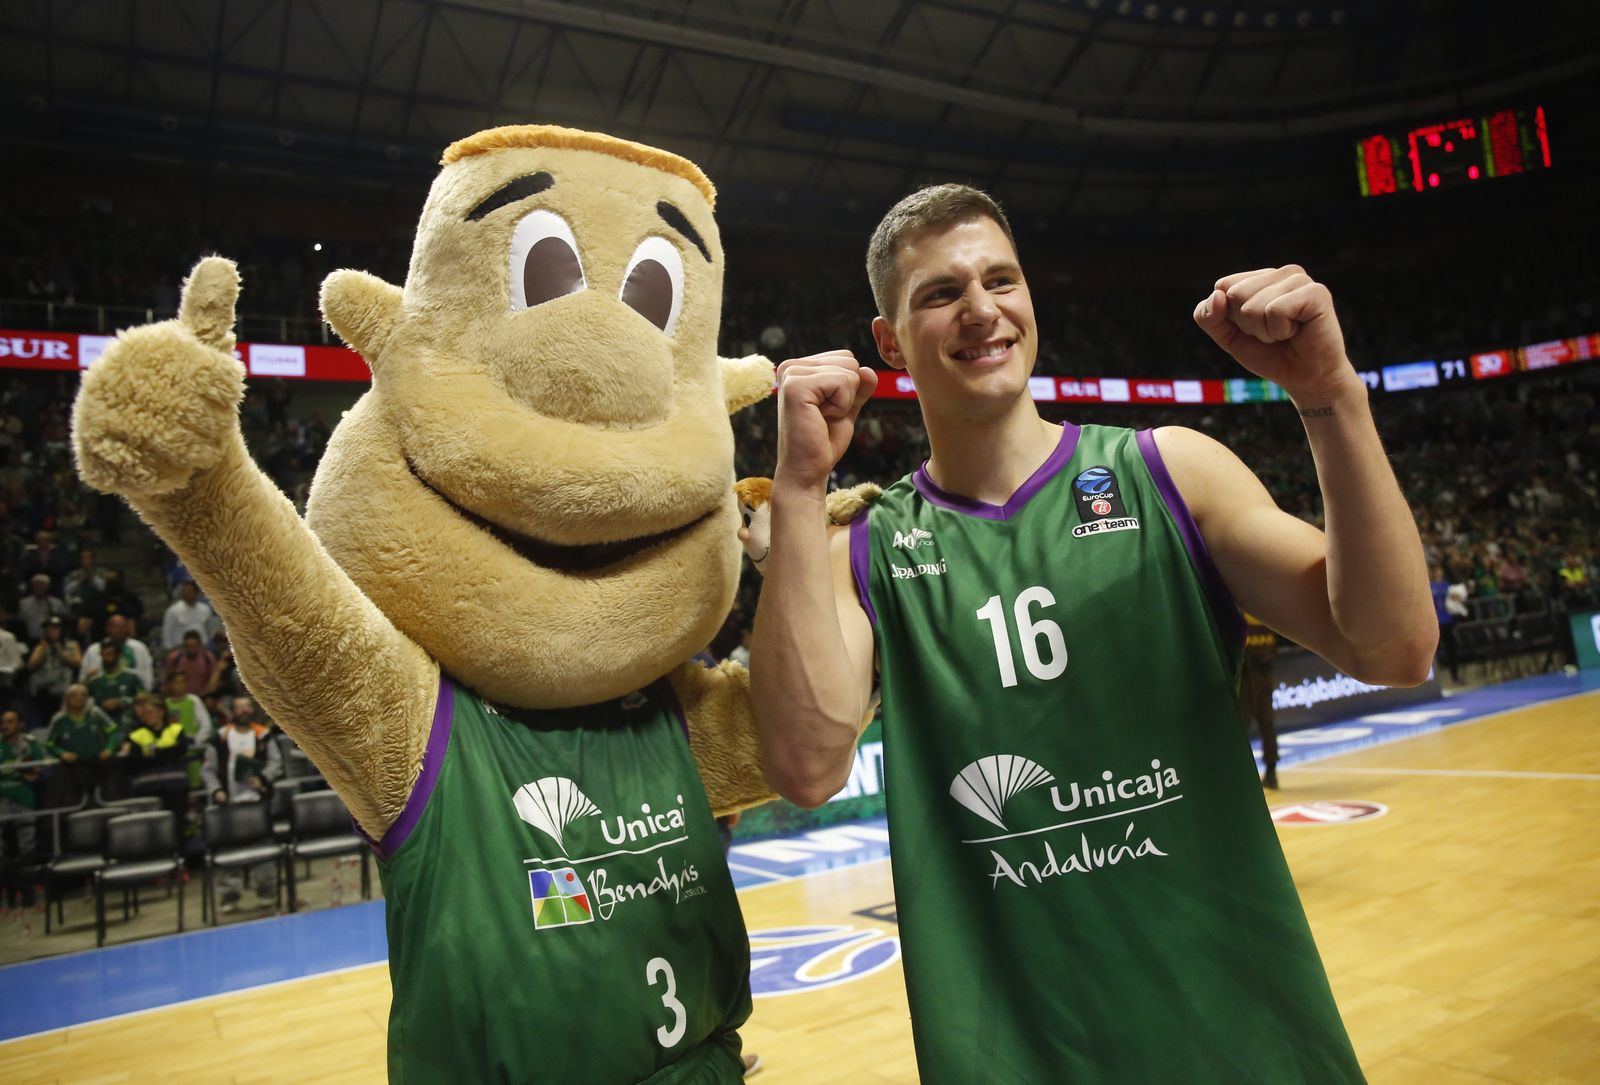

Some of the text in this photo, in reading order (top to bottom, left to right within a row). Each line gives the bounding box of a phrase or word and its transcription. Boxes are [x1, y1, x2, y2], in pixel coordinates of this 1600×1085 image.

[1441, 359, 1466, 379] 71
[1060, 373, 1099, 397] SUR
[1137, 375, 1173, 398] SUR
[1082, 492, 1114, 502] EuroCup
[891, 557, 947, 580] SPALDING
[976, 586, 1068, 688] 16
[1050, 758, 1181, 813] Unicaja
[988, 821, 1169, 891] Andalucía
[646, 956, 687, 1048] 3
